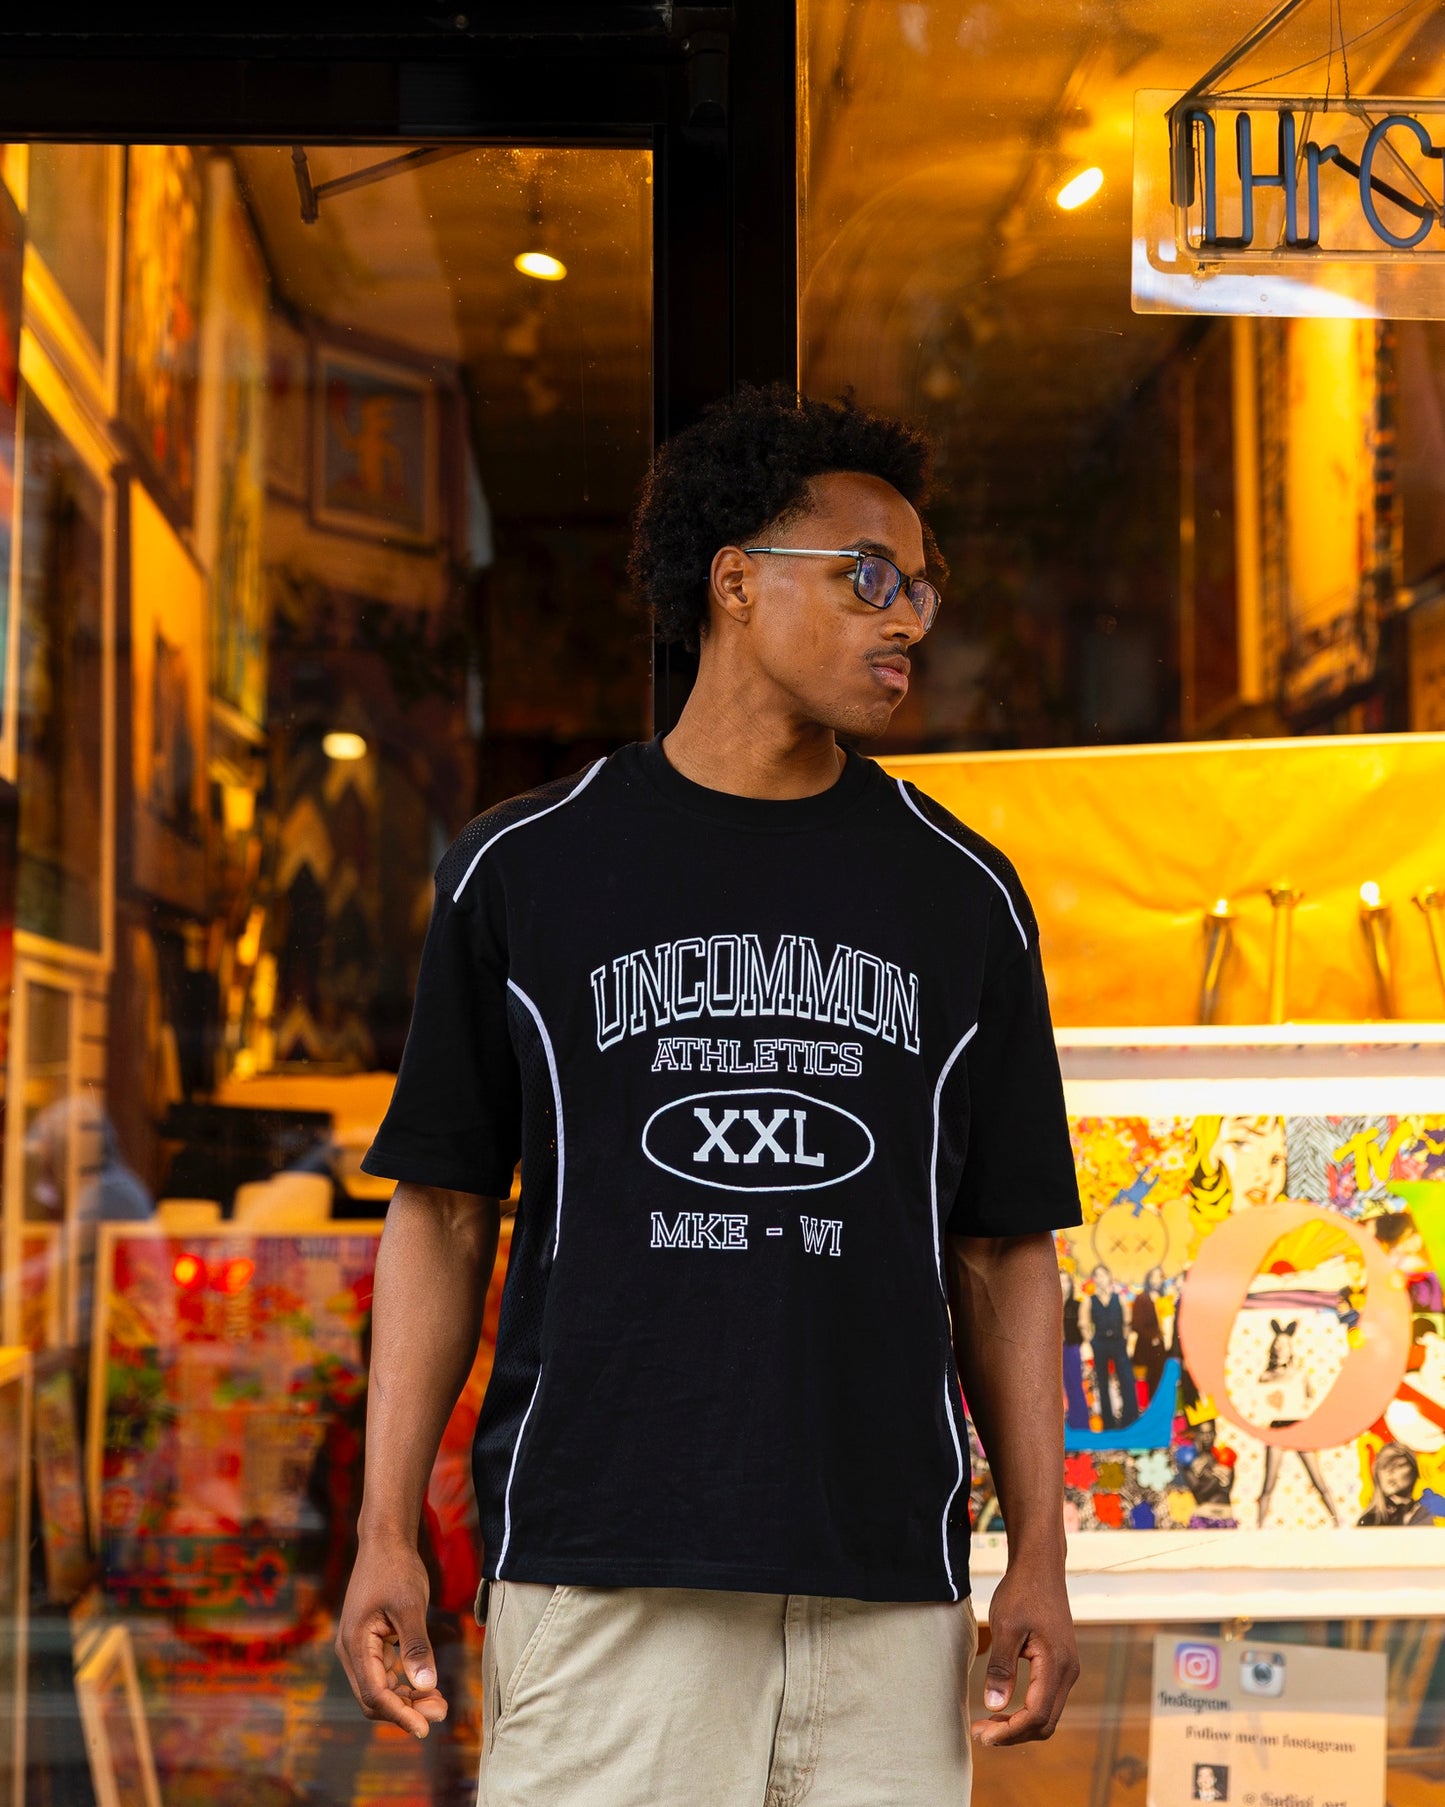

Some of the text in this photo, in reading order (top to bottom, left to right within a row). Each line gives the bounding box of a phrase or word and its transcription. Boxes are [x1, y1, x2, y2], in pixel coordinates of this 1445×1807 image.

[591, 934, 920, 1055] UNCOMMON
[651, 1037, 863, 1077] ATHLETICS
[693, 1107, 825, 1167] XXL
[650, 1212, 748, 1250] MKE
[800, 1215, 843, 1257] WI
[1158, 1691, 1232, 1714] Instagram
[1186, 1725, 1232, 1742] Follow
[1282, 1734, 1357, 1754] Instagram
